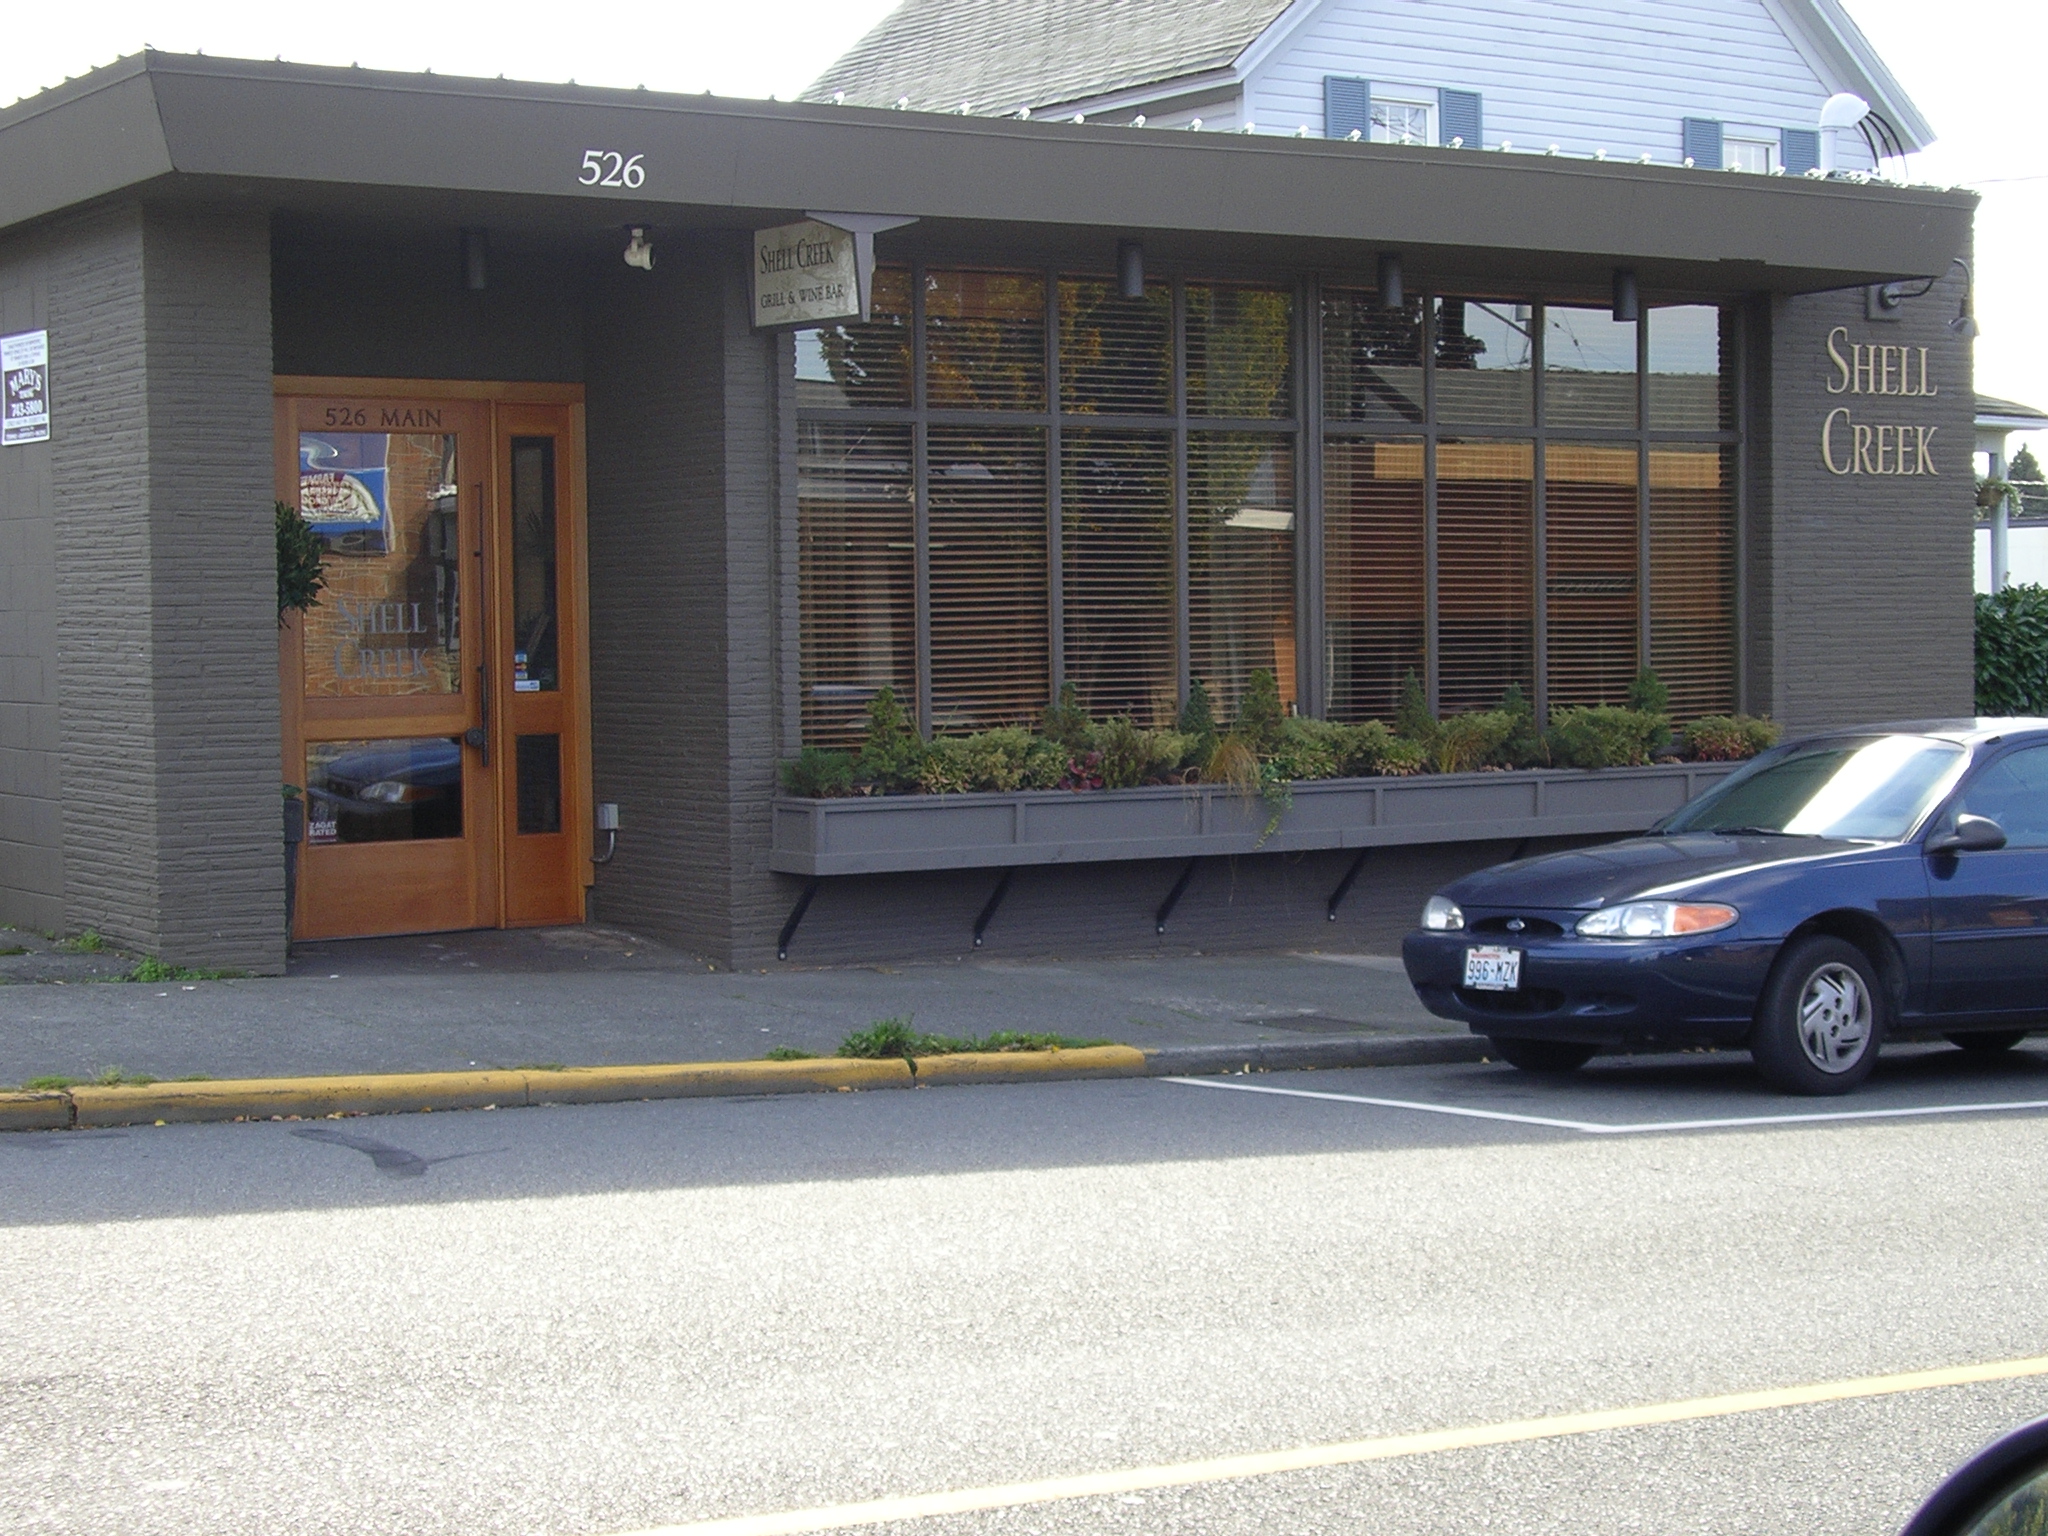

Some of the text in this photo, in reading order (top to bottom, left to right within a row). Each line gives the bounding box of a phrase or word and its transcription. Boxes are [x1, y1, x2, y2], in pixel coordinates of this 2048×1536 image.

[578, 150, 645, 189] 526
[760, 238, 834, 274] SHELL CREEK
[760, 283, 844, 309] GRILL & WINE BAR
[1826, 326, 1938, 396] SHELL
[325, 407, 442, 428] 526 MAIN
[1822, 407, 1939, 476] CREEK
[336, 593, 428, 634] SHELL
[334, 637, 429, 679] CREEK
